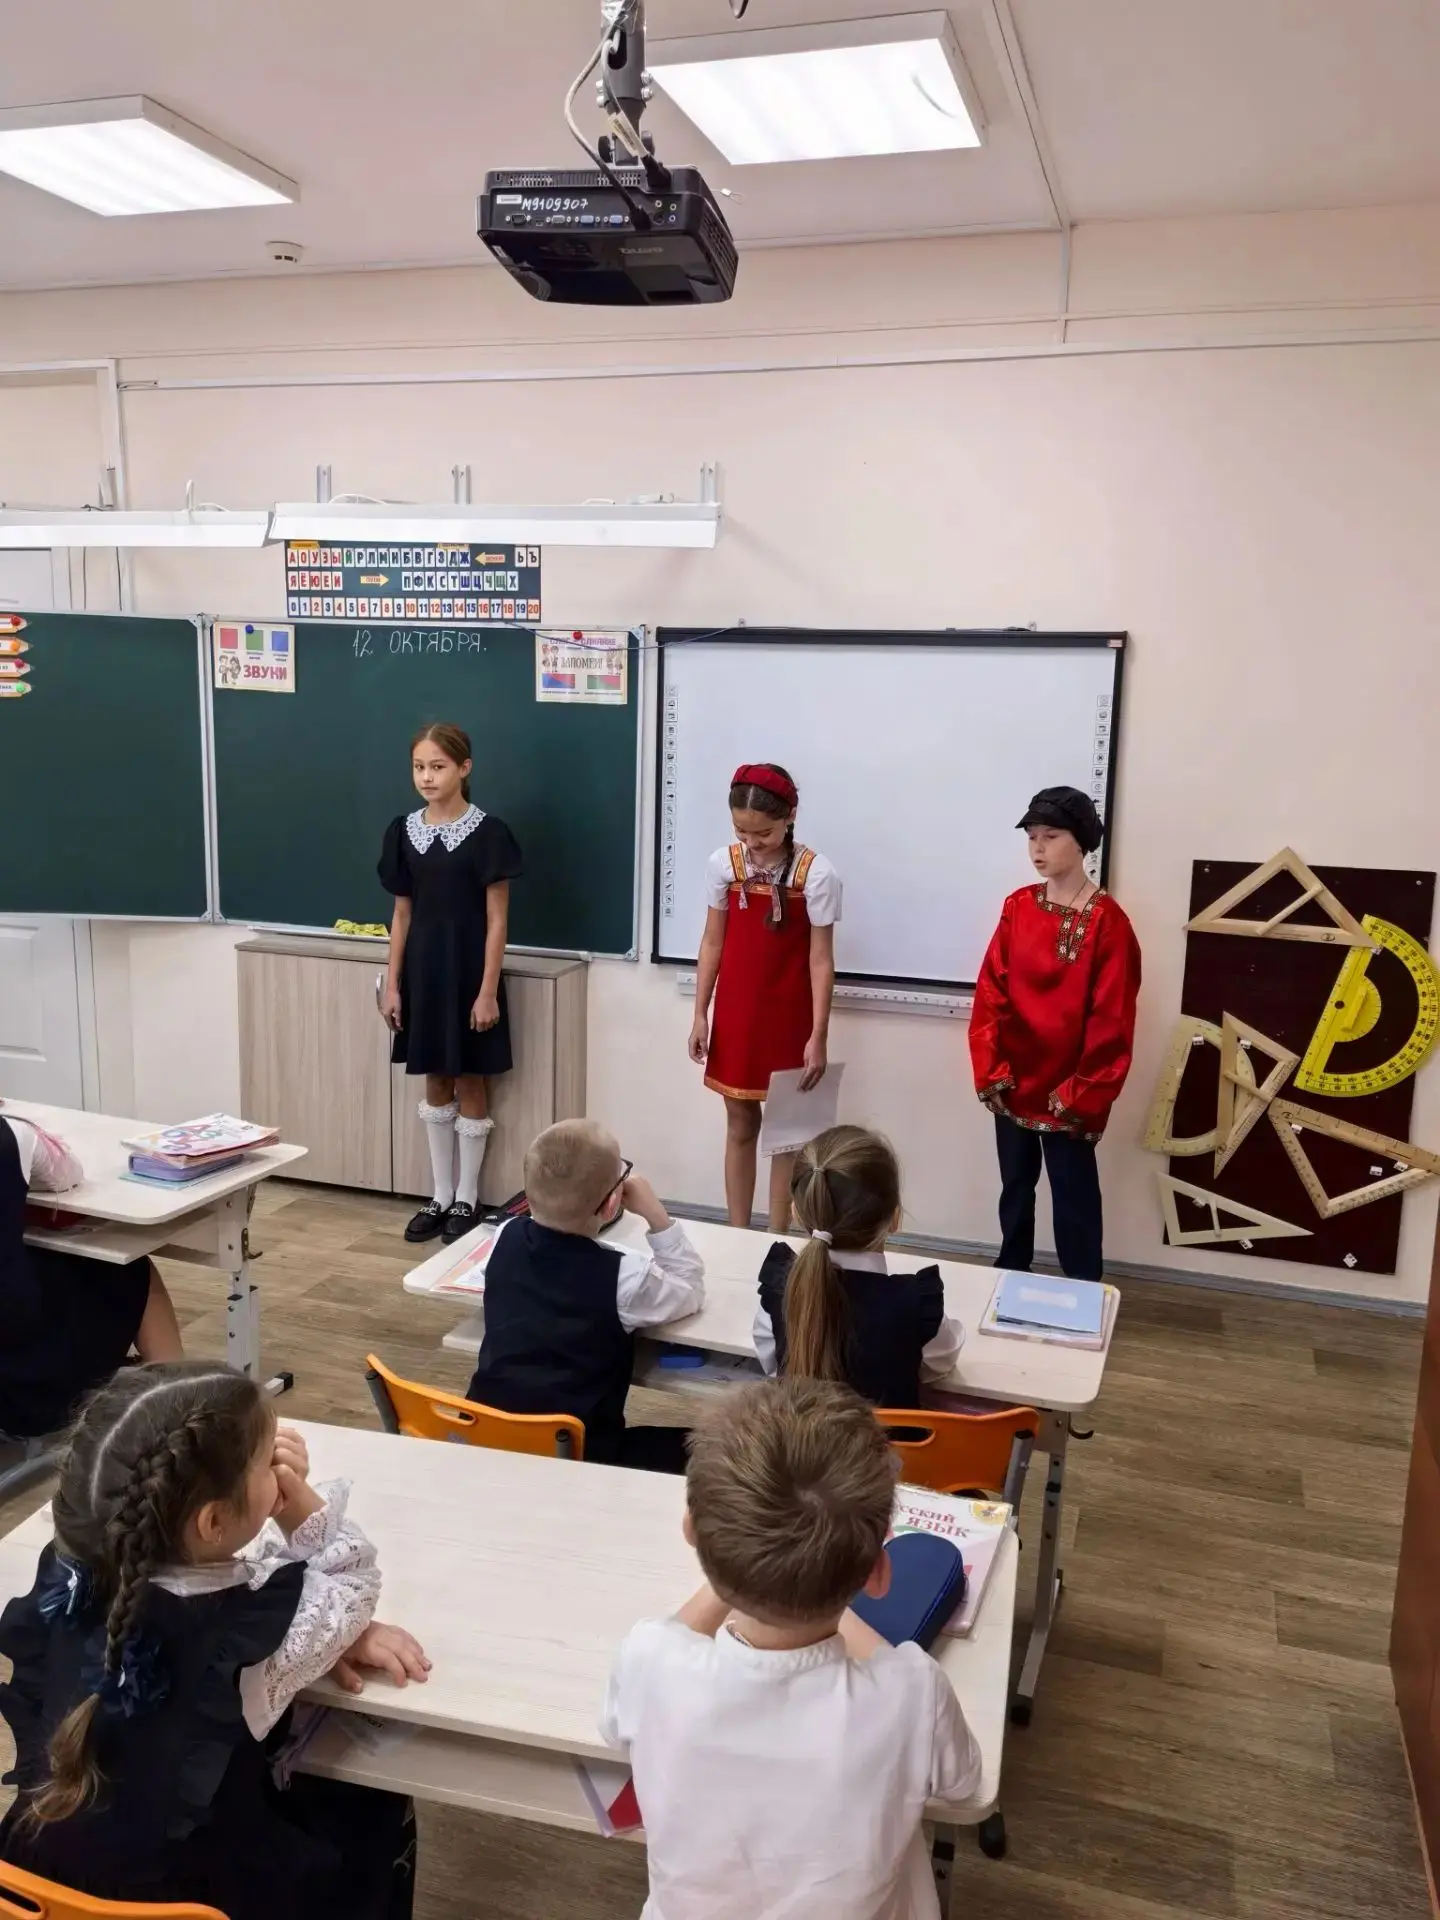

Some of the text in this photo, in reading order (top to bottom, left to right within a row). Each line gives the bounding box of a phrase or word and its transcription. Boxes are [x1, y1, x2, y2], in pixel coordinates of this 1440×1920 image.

[389, 630, 487, 654] ОКТЯБРЯ.
[243, 664, 288, 680] ЗВУКИ
[906, 1516, 970, 1538] ЯЗЫК
